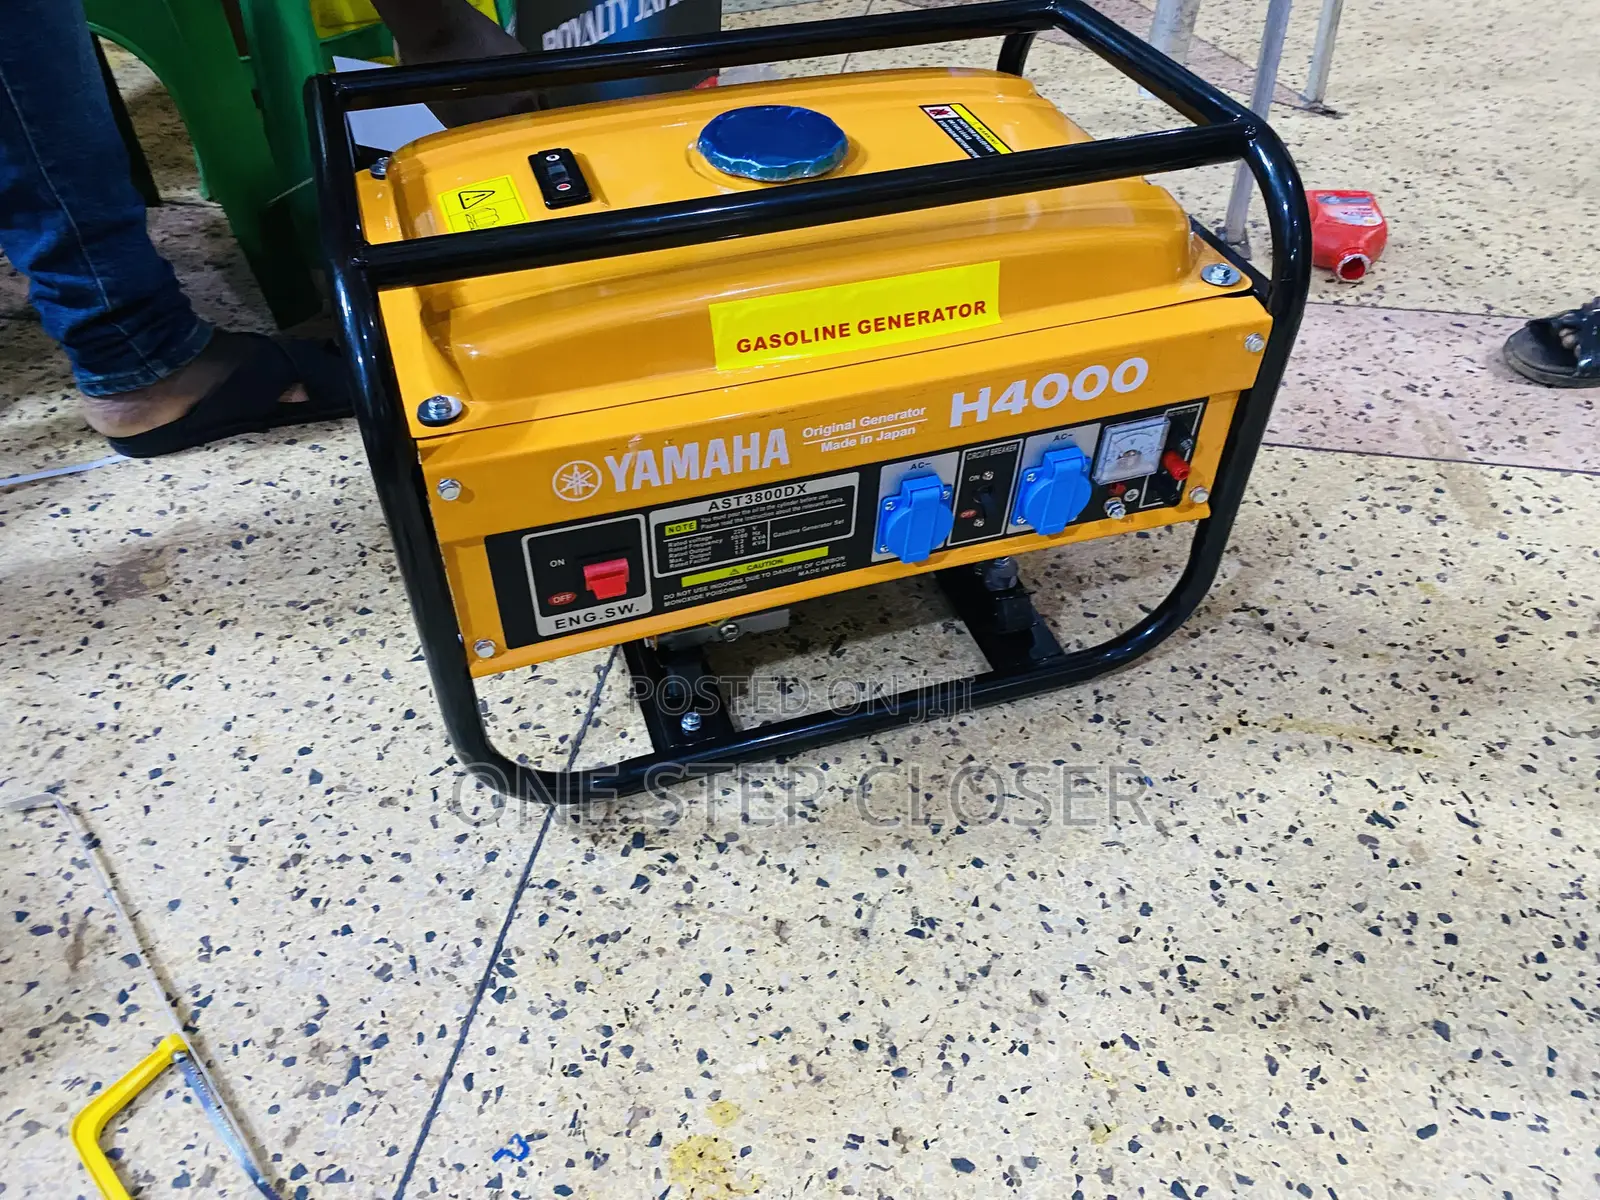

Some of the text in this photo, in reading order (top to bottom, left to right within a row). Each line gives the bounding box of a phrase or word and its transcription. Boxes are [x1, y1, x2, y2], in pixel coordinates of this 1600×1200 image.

[736, 300, 987, 353] GASOLINE GENERATOR
[949, 357, 1149, 428] H4000
[802, 407, 926, 438] Original Generator
[820, 427, 916, 452] Made in Japan
[603, 428, 790, 493] YAMAHA
[708, 483, 807, 512] AST3800DX
[668, 522, 694, 534] NOTE
[773, 528, 800, 538] Gasoline
[801, 522, 832, 532] Generator
[668, 540, 688, 548] Rated
[549, 558, 565, 568] ON
[669, 561, 689, 569] Rated
[746, 558, 784, 570] CAUTION
[798, 568, 820, 577] MADE
[676, 589, 692, 597] NOT
[693, 586, 709, 594] USE
[709, 578, 744, 590] INDOORS
[744, 574, 760, 582] DUE
[772, 565, 802, 576] DANGER
[815, 556, 846, 566] CARBON
[552, 593, 573, 604] OFF
[663, 584, 748, 607] MONOXIDE POISONING
[555, 603, 640, 629] ENG.SW.
